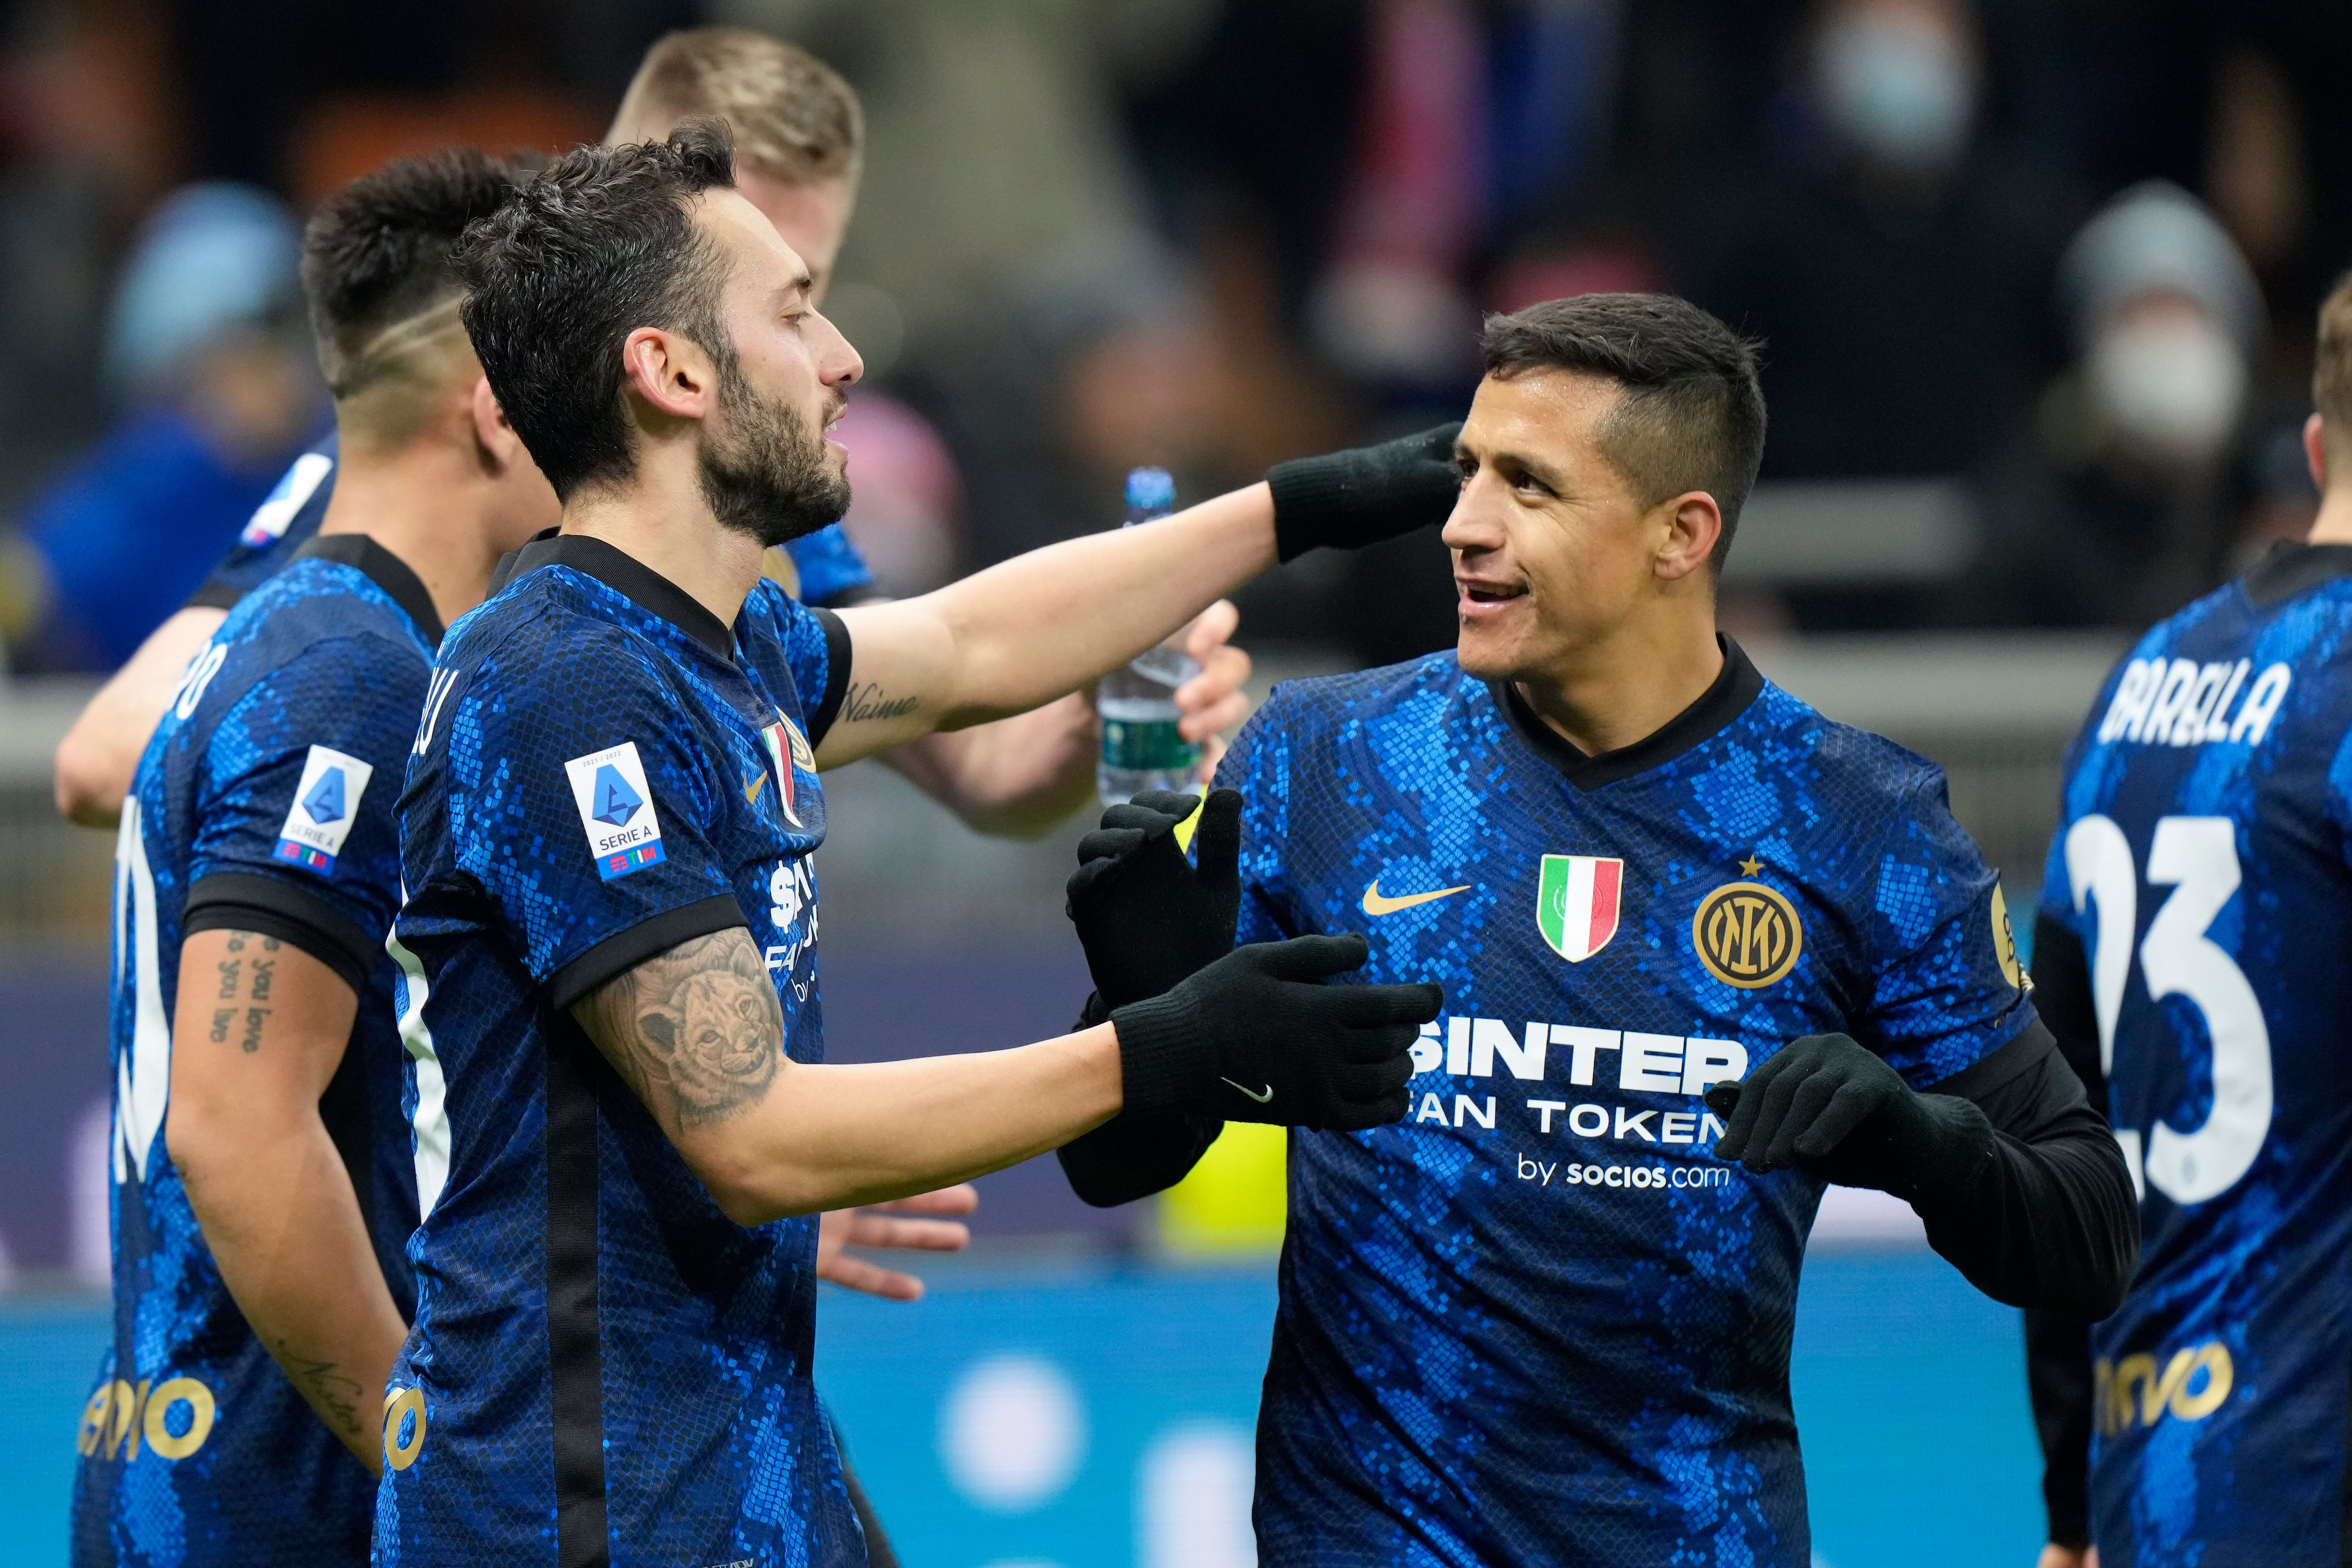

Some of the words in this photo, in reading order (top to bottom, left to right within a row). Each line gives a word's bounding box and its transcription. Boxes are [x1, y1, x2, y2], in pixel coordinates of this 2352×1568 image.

[582, 757, 598, 767] 2021
[605, 751, 621, 761] 2022
[290, 824, 326, 844] SERIE
[599, 828, 641, 851] SERIE
[644, 826, 652, 838] A
[627, 845, 657, 865] TIM
[791, 978, 809, 1003] by
[2066, 813, 2273, 1205] 23
[1408, 1091, 1497, 1129] AN
[1527, 1099, 1728, 1145] TOKEN
[1517, 1153, 1557, 1186] by
[1566, 1162, 1730, 1189] socios.com
